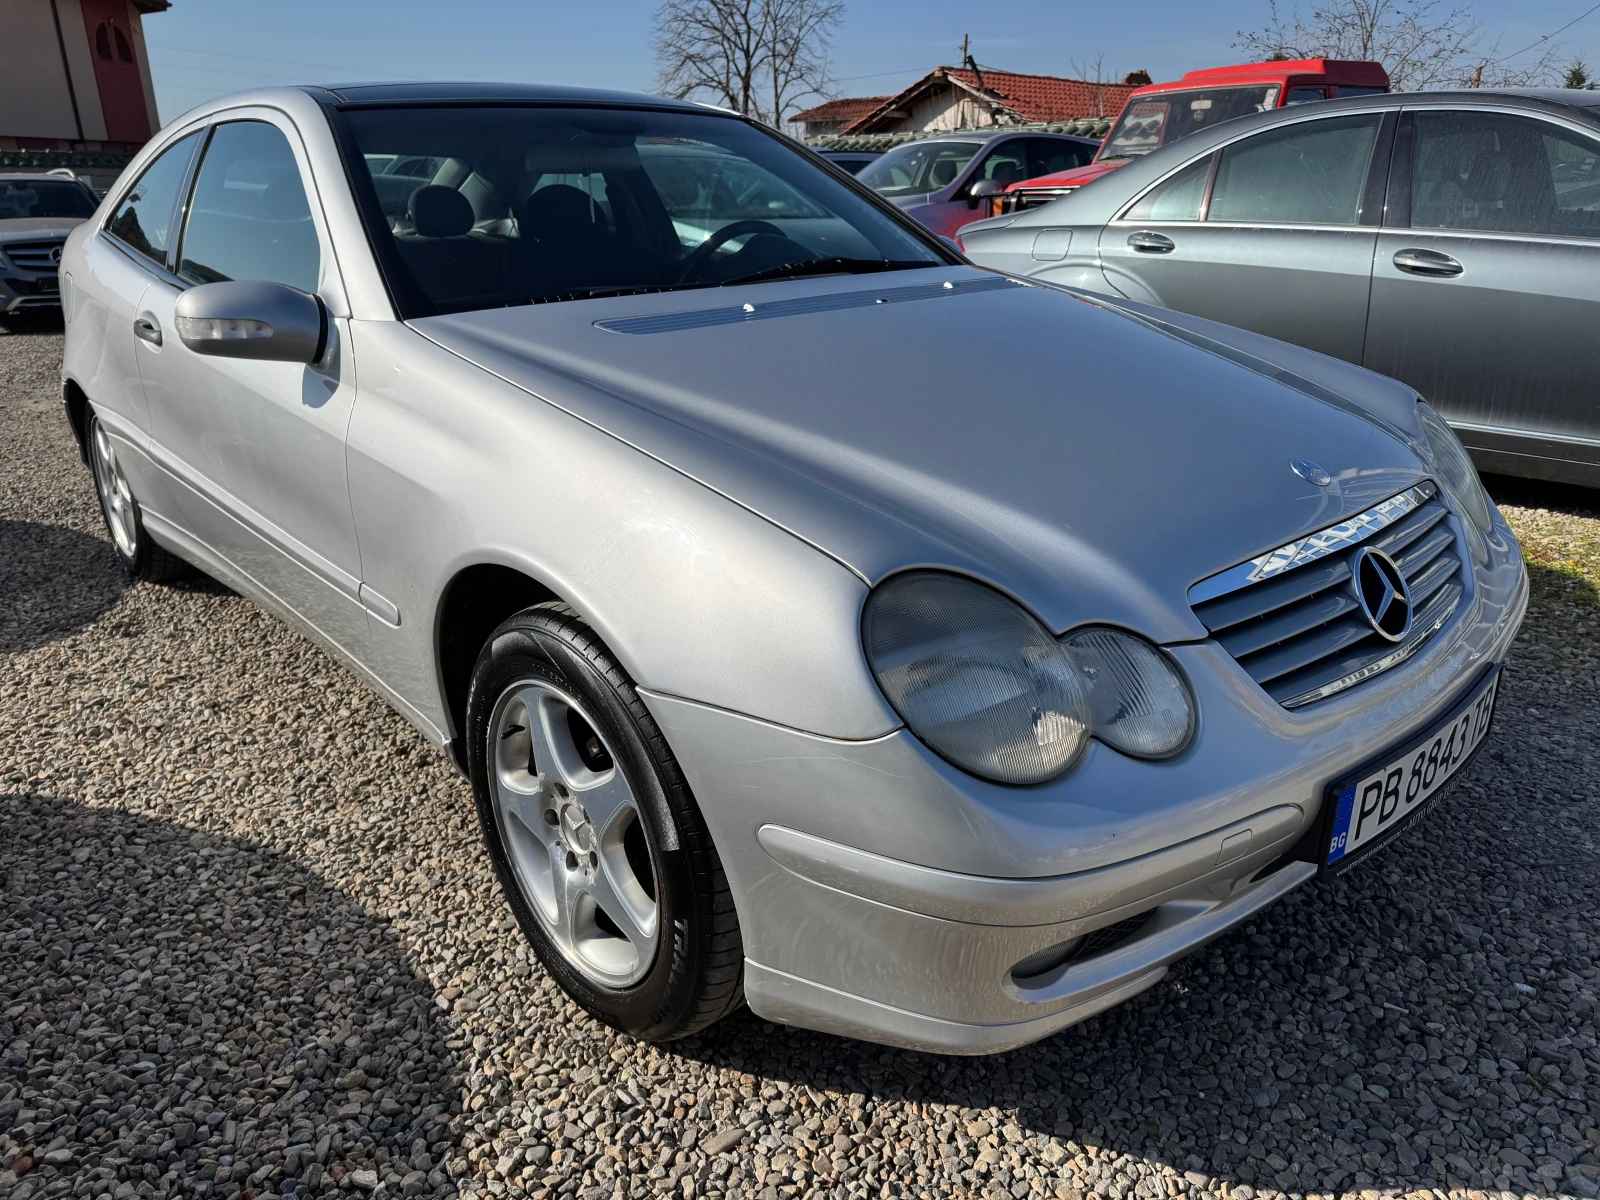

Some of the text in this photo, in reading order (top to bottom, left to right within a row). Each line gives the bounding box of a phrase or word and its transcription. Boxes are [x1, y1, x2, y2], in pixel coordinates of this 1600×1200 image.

[1354, 767, 1403, 841] PB
[1406, 713, 1470, 804] 8843
[1329, 831, 1347, 854] BG
